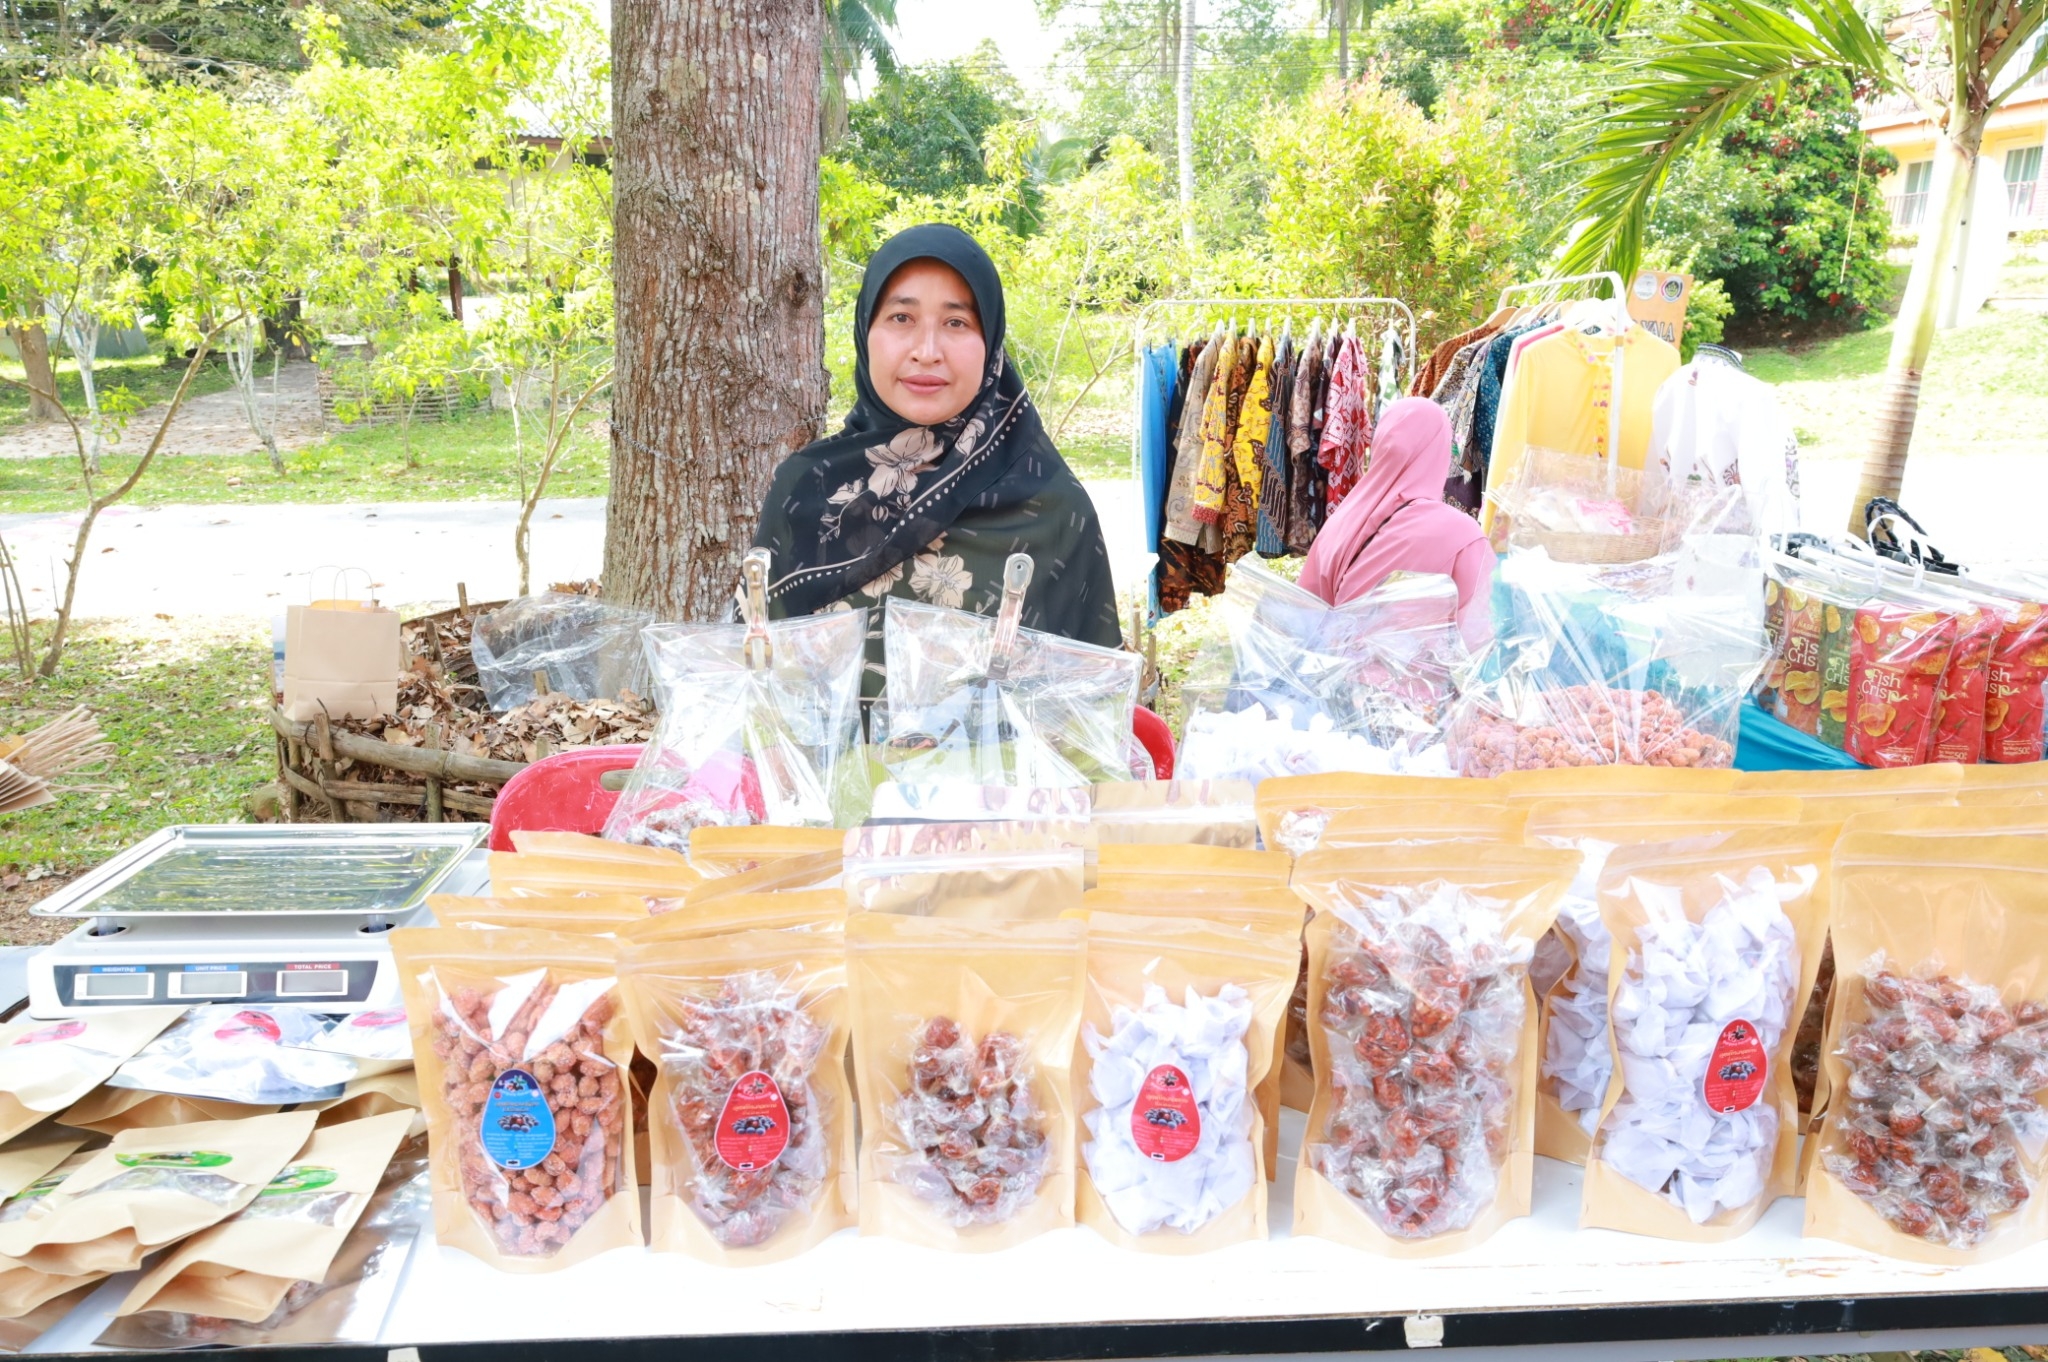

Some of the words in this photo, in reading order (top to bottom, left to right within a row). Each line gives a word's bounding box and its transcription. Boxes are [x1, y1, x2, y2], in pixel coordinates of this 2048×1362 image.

[1794, 636, 1819, 655] Fis
[1788, 647, 1820, 671] Cris
[1825, 667, 1849, 686] Cris
[1867, 668, 1901, 689] Fish
[1986, 667, 2011, 682] ish
[1861, 680, 1909, 704] Crisp
[1984, 680, 2020, 698] isp
